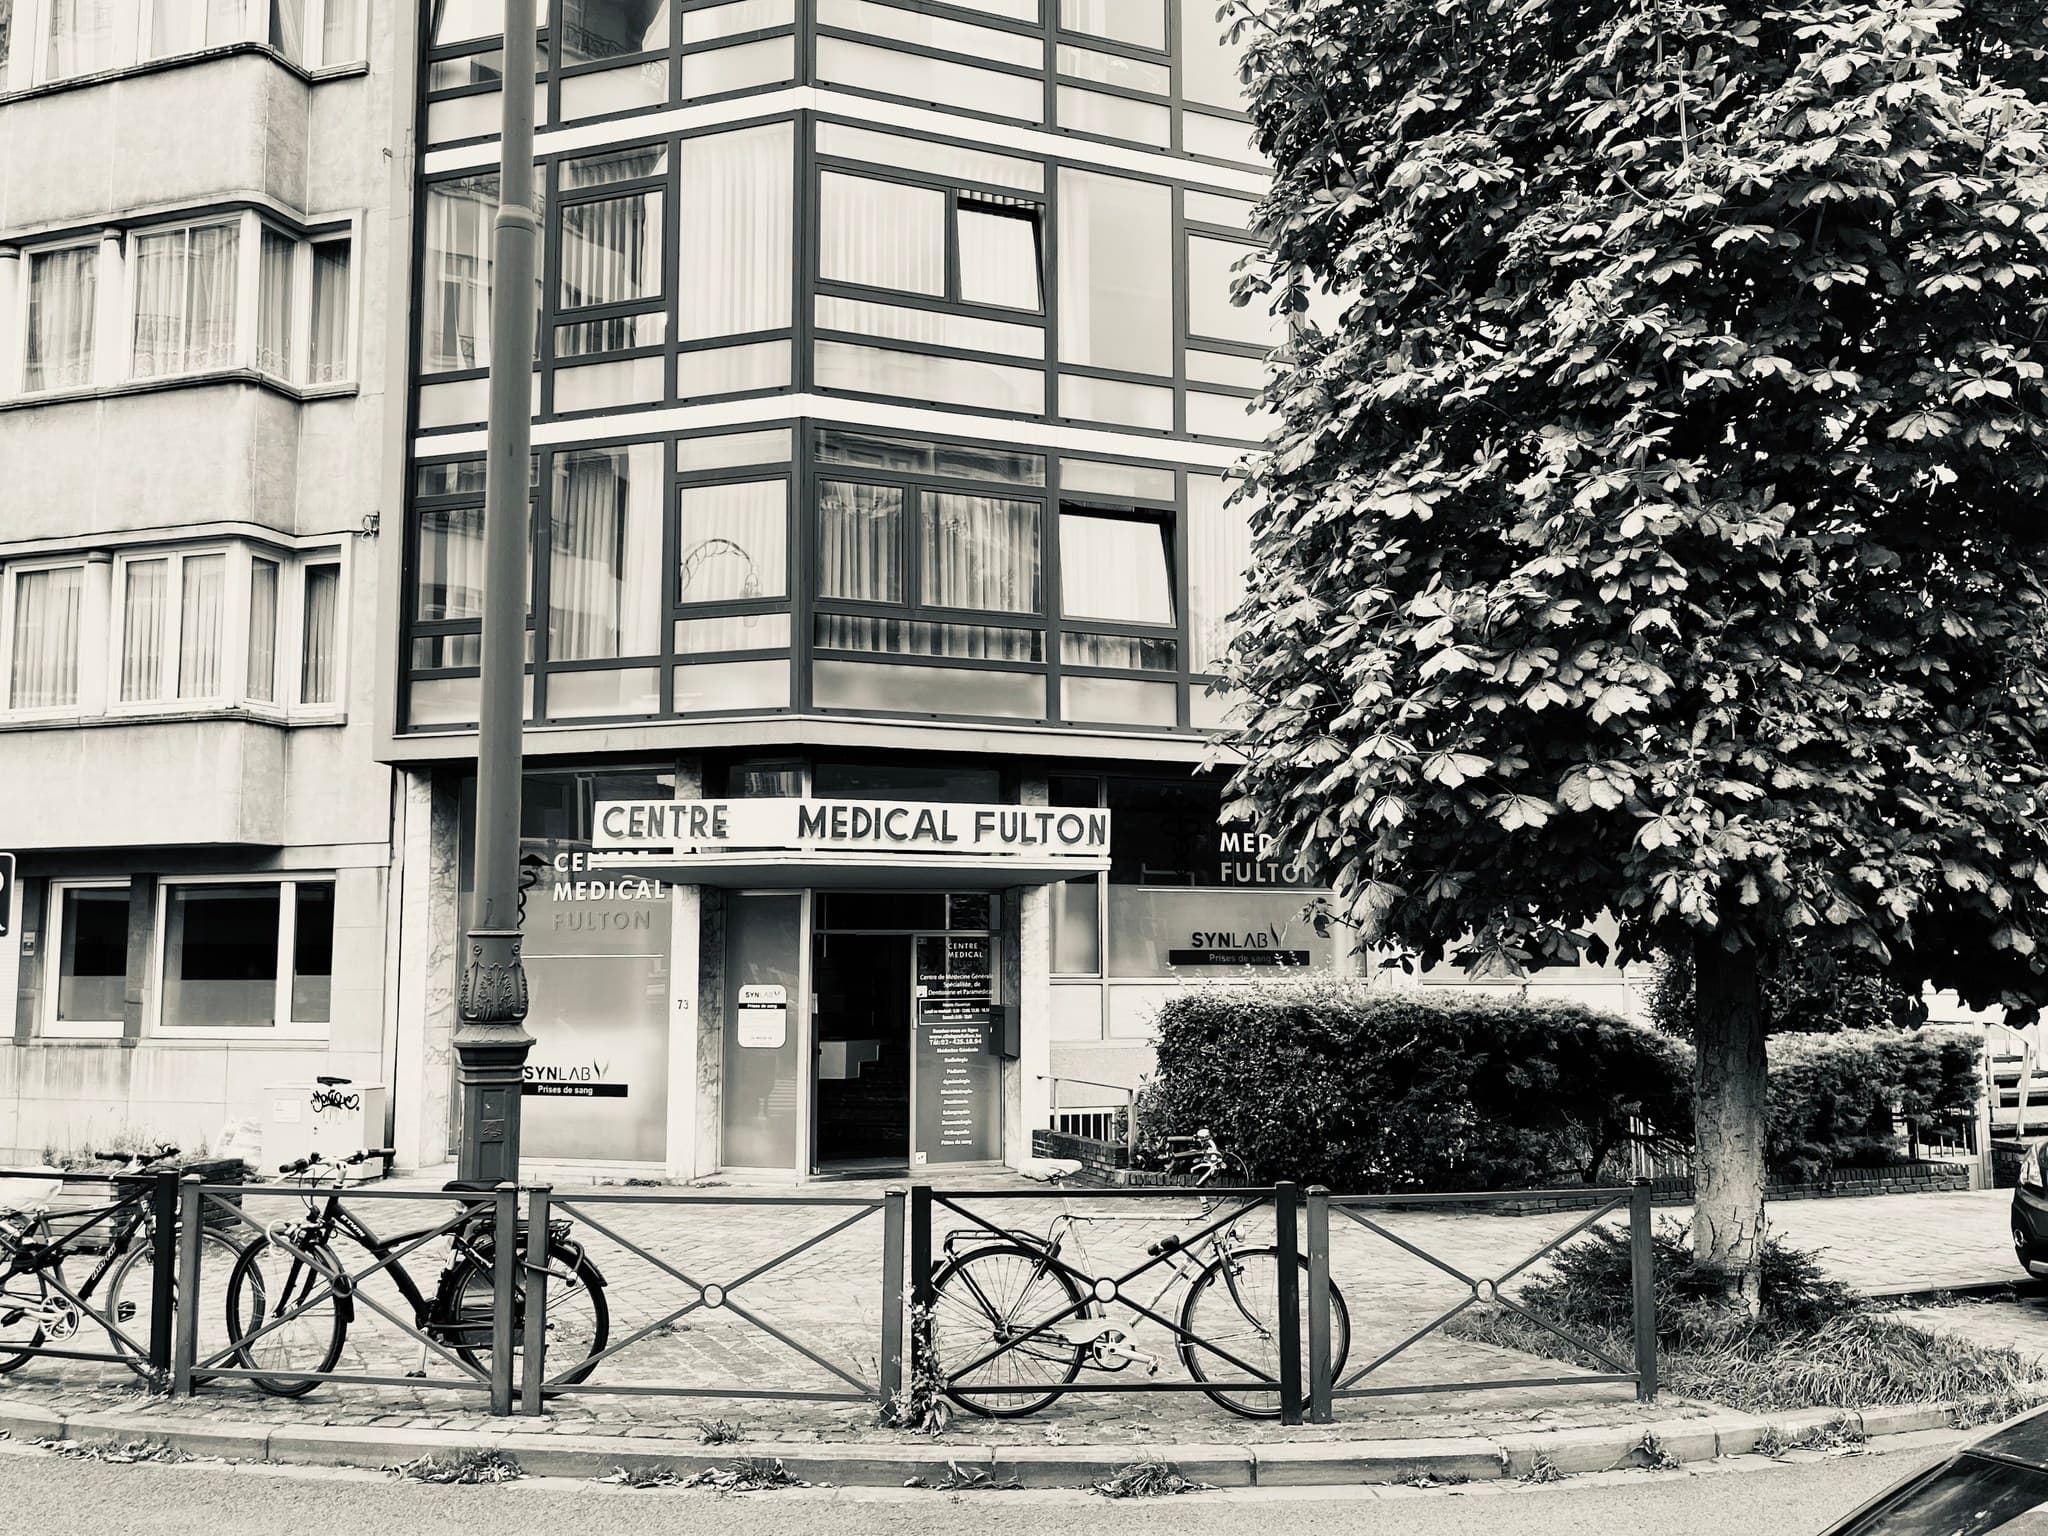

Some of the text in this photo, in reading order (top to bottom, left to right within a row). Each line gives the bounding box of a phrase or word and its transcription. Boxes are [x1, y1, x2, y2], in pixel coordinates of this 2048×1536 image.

[602, 804, 1107, 846] CENTRE MEDICAL FULTON
[553, 880, 665, 902] MEDICAL
[553, 911, 651, 931] FULTON
[1191, 932, 1268, 948] SYNLAB
[1209, 953, 1236, 962] Prises
[1238, 954, 1249, 962] de
[677, 1000, 689, 1010] 73
[524, 1066, 591, 1080] SYNLAB
[537, 1085, 594, 1096] Prises de sang
